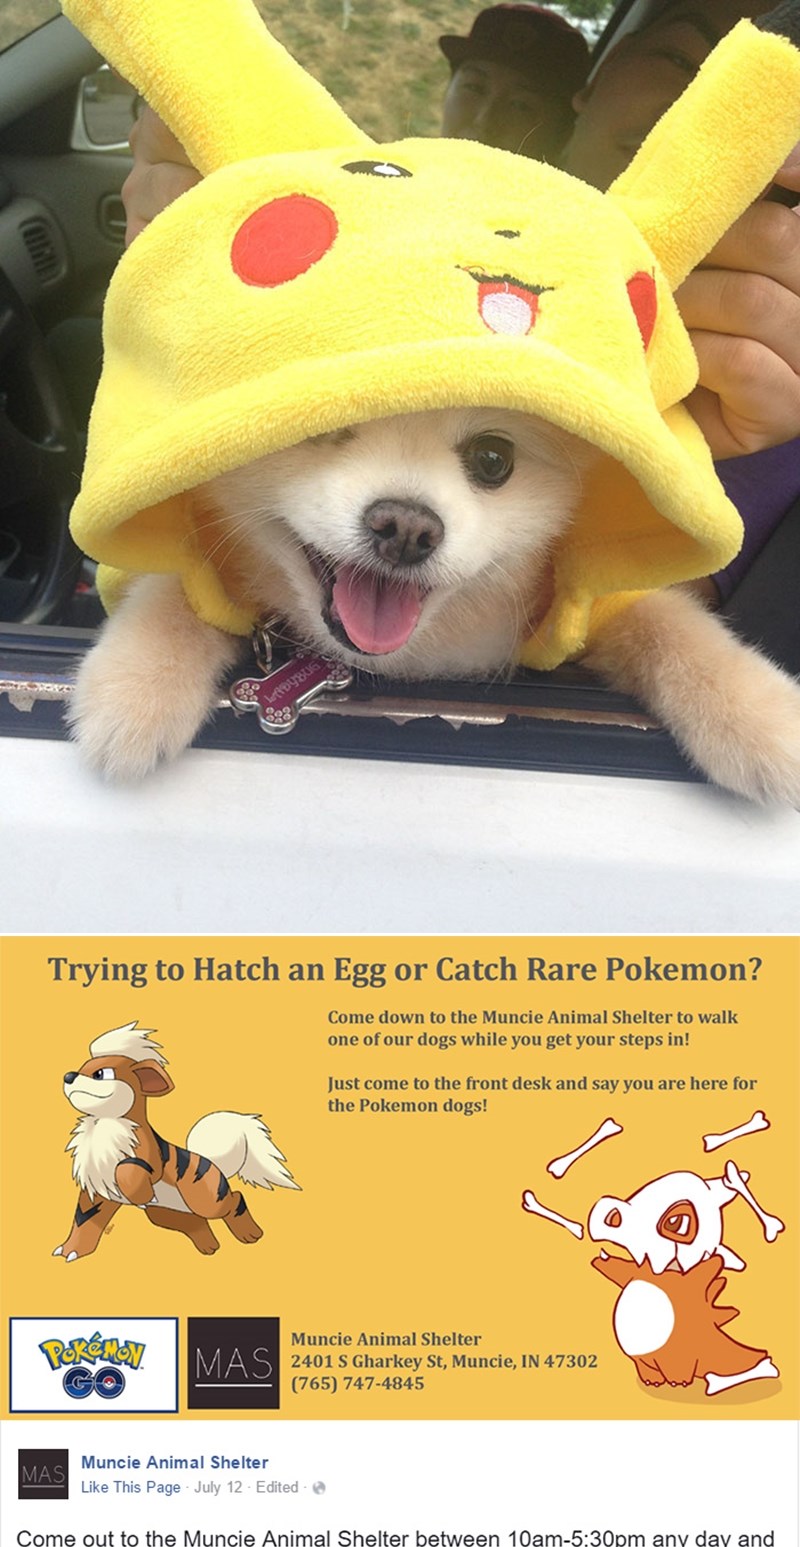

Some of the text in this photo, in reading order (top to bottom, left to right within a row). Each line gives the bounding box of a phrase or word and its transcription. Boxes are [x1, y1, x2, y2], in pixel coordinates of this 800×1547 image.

[47, 955, 763, 989] Trying to Hatch an Egg or Catch Rare Pokemon?
[327, 1009, 739, 1025] Come down to the Muncie Animal Shelter to walk
[327, 1031, 690, 1051] one of our dogs while you get your steps in!
[327, 1075, 758, 1095] Just come to the front desk and say you are here for
[327, 1097, 488, 1116] the Pokemon dogs!
[291, 1331, 483, 1347] Muncie Animal Shelter
[195, 1347, 273, 1380] MAS
[291, 1353, 598, 1373] 2401 S Gharkey St, Muncie, IN 47302
[62, 1366, 126, 1399] GO
[291, 1375, 425, 1395] (765) 747-4845
[81, 1454, 270, 1470] Muncie Animal Shelter
[22, 1465, 65, 1484] MAS
[81, 1480, 299, 1497] Like This Page July 12 Edited
